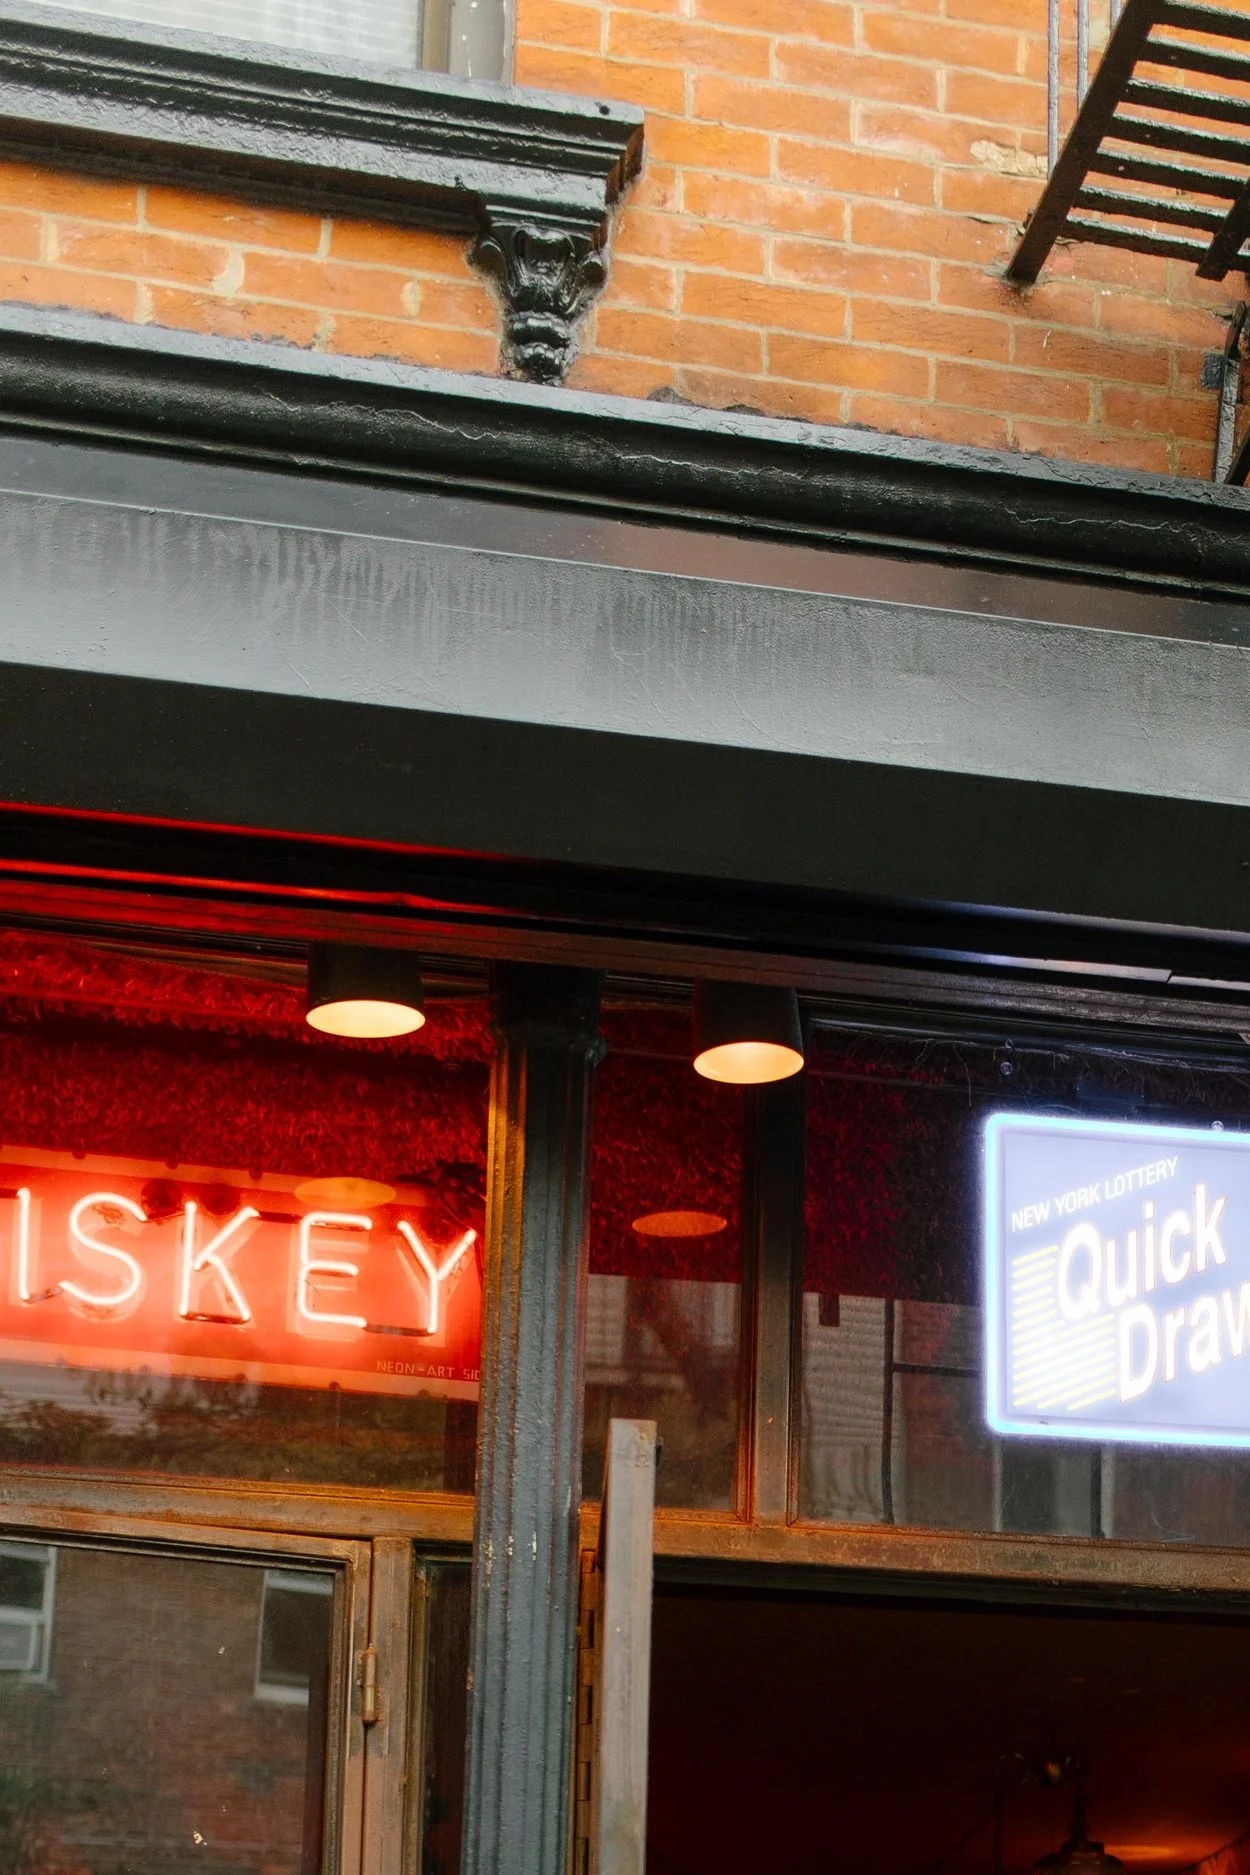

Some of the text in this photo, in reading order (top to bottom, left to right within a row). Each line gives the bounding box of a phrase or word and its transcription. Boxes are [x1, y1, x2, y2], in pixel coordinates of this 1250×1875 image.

[16, 1184, 479, 1337] ISKEY
[1011, 1156, 1179, 1233] NEW YORK LOTTERY
[1057, 1181, 1228, 1321] Quick
